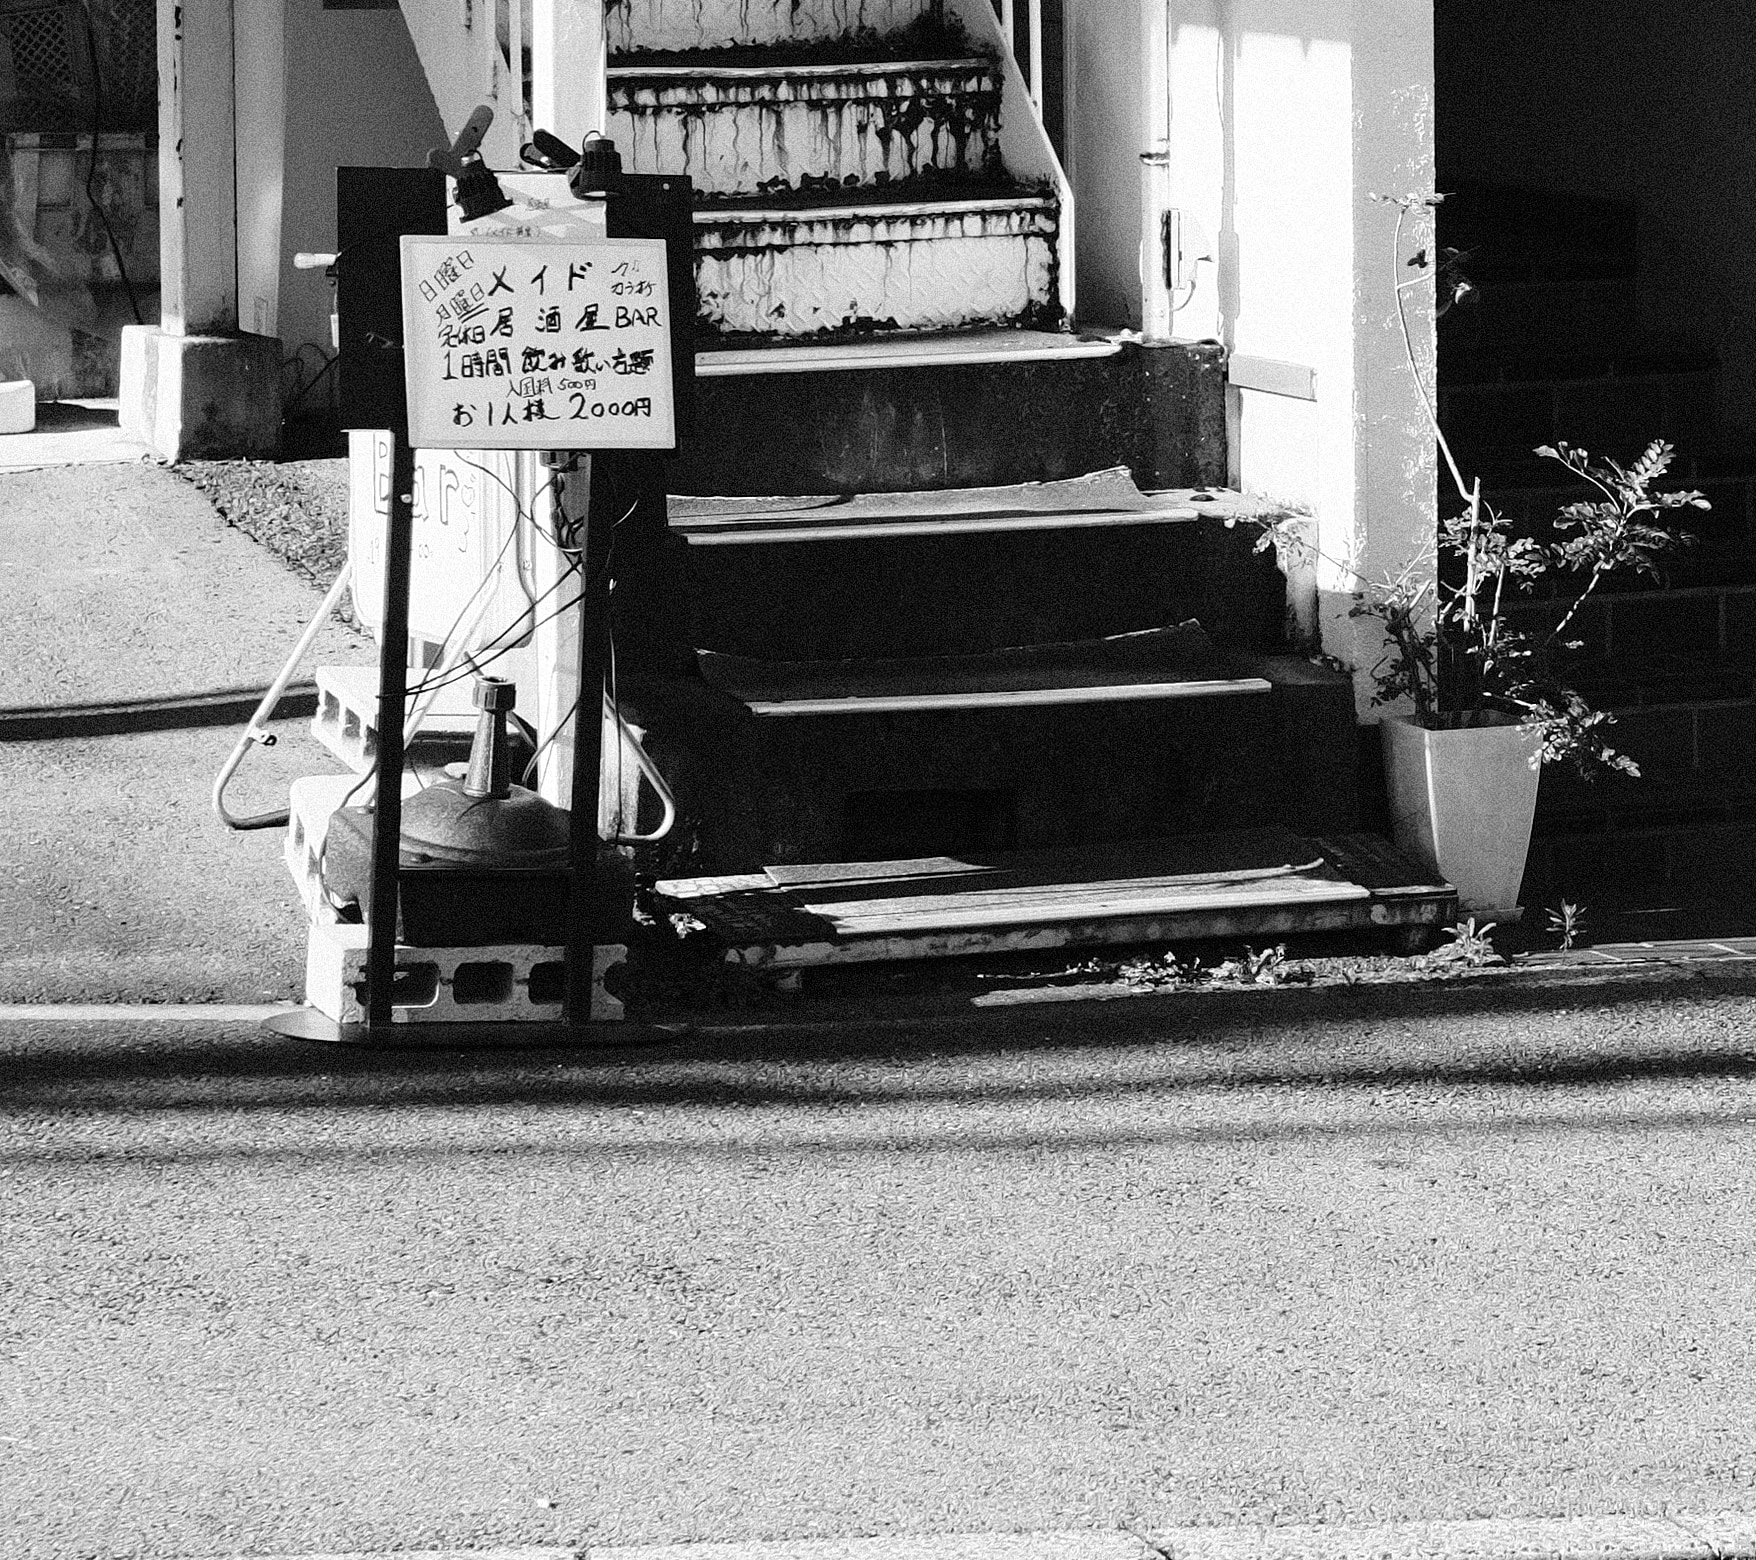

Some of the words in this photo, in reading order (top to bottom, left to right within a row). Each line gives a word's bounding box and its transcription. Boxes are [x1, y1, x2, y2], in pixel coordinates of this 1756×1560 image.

[418, 249, 475, 303] 日曜日
[487, 261, 593, 297] メイド
[435, 281, 485, 328] 月曜日
[489, 303, 610, 338] 居酒屋
[615, 305, 662, 329] BAR
[438, 324, 486, 348] 定休日
[441, 346, 513, 380] 1時間
[557, 377, 597, 391] 500円
[568, 391, 652, 420] 2000円
